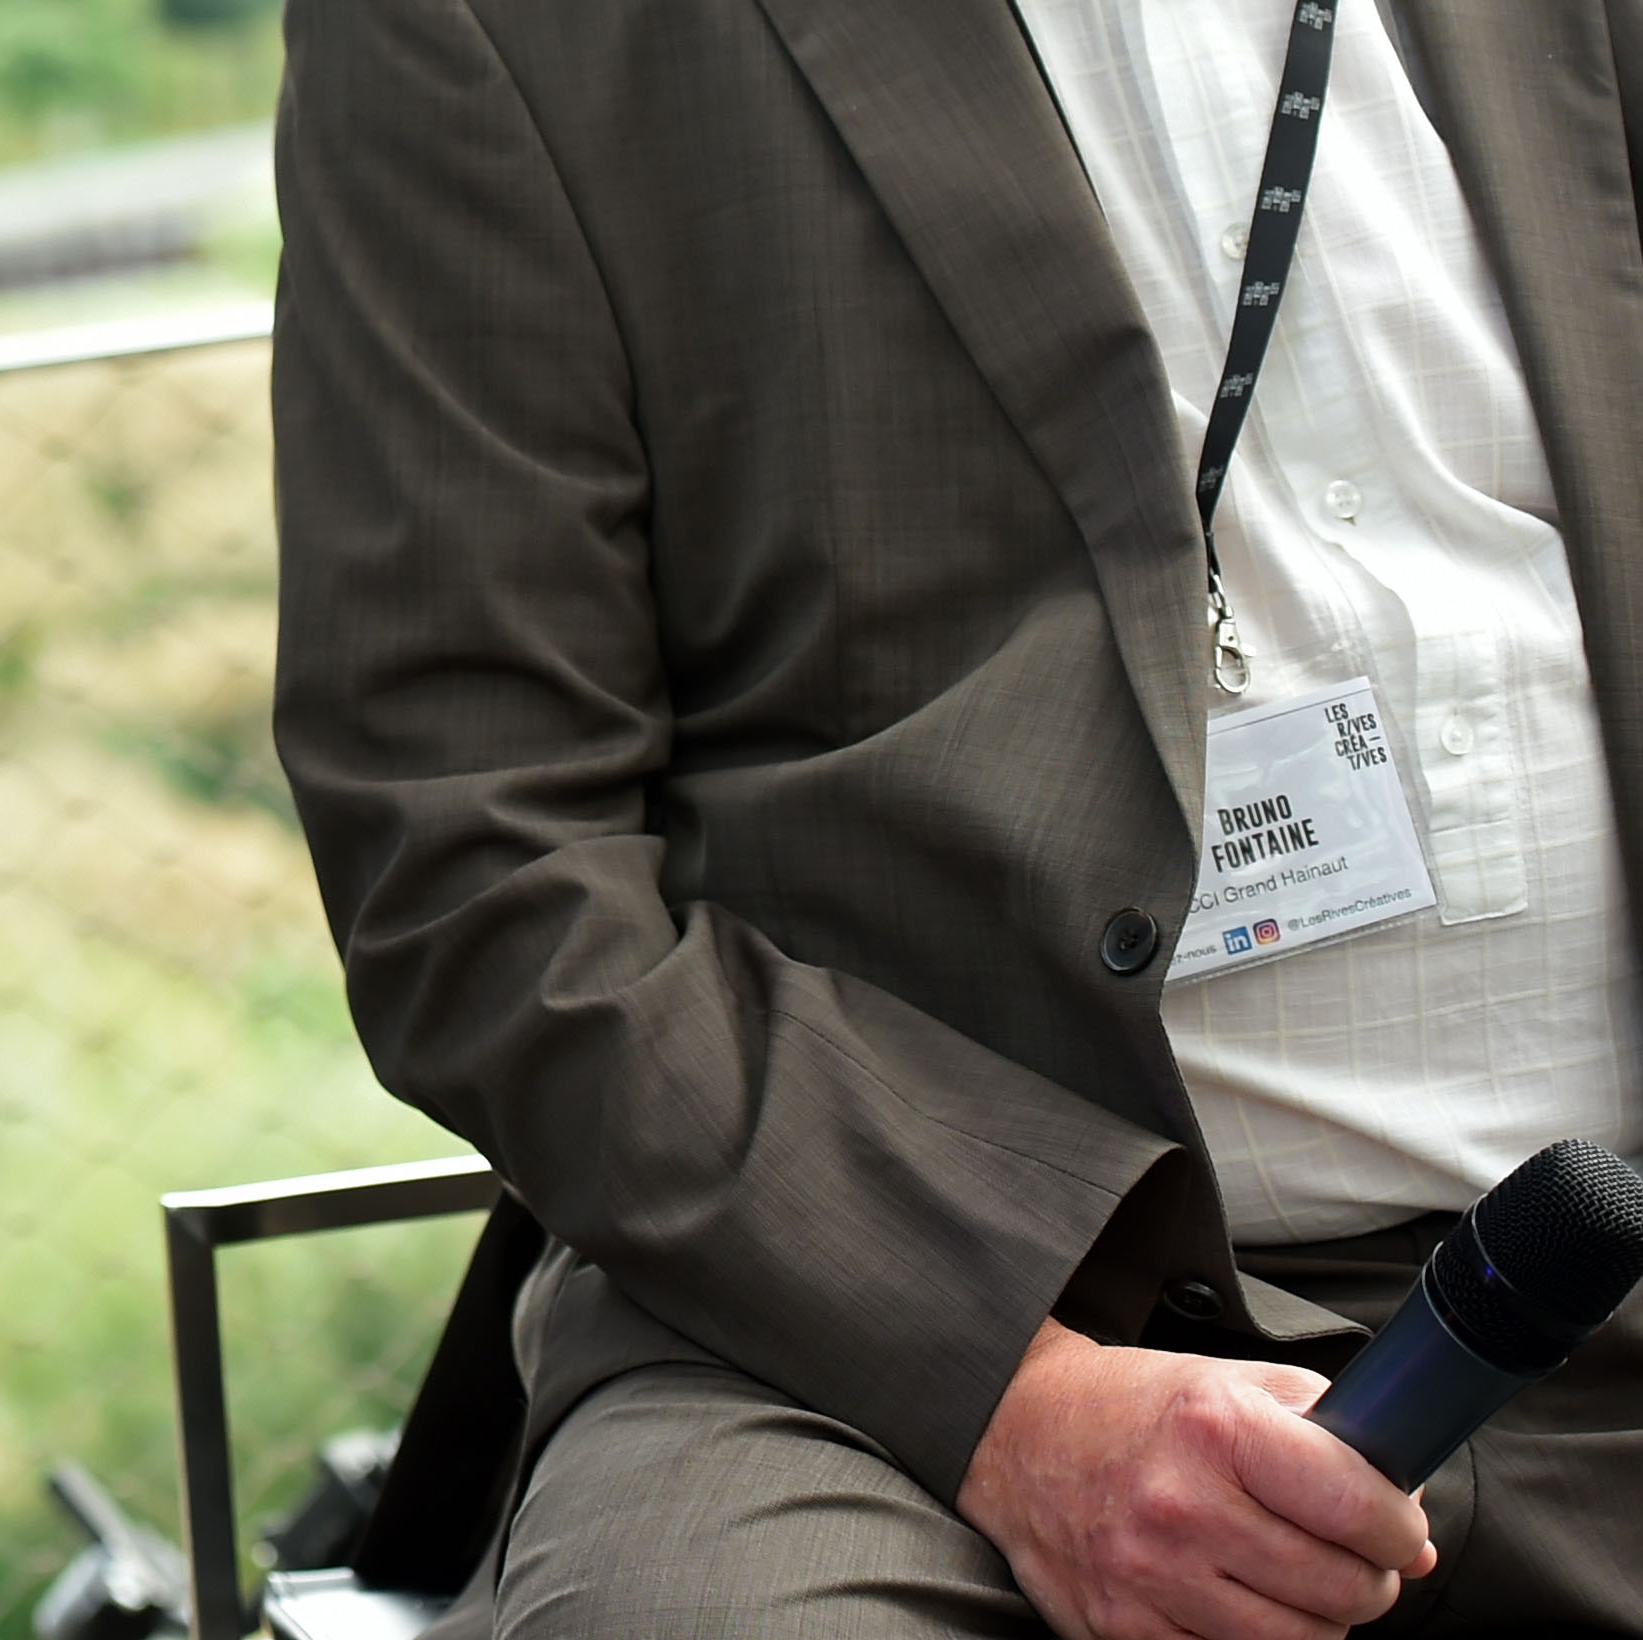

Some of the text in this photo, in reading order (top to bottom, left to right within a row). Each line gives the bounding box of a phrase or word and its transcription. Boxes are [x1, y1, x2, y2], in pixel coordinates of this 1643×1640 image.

[1324, 702, 1349, 723] LES
[1217, 794, 1293, 836] BRUNO
[1211, 818, 1320, 874] FONTAINE
[1223, 875, 1278, 904] Grand
[1281, 856, 1349, 888] Hainaut
